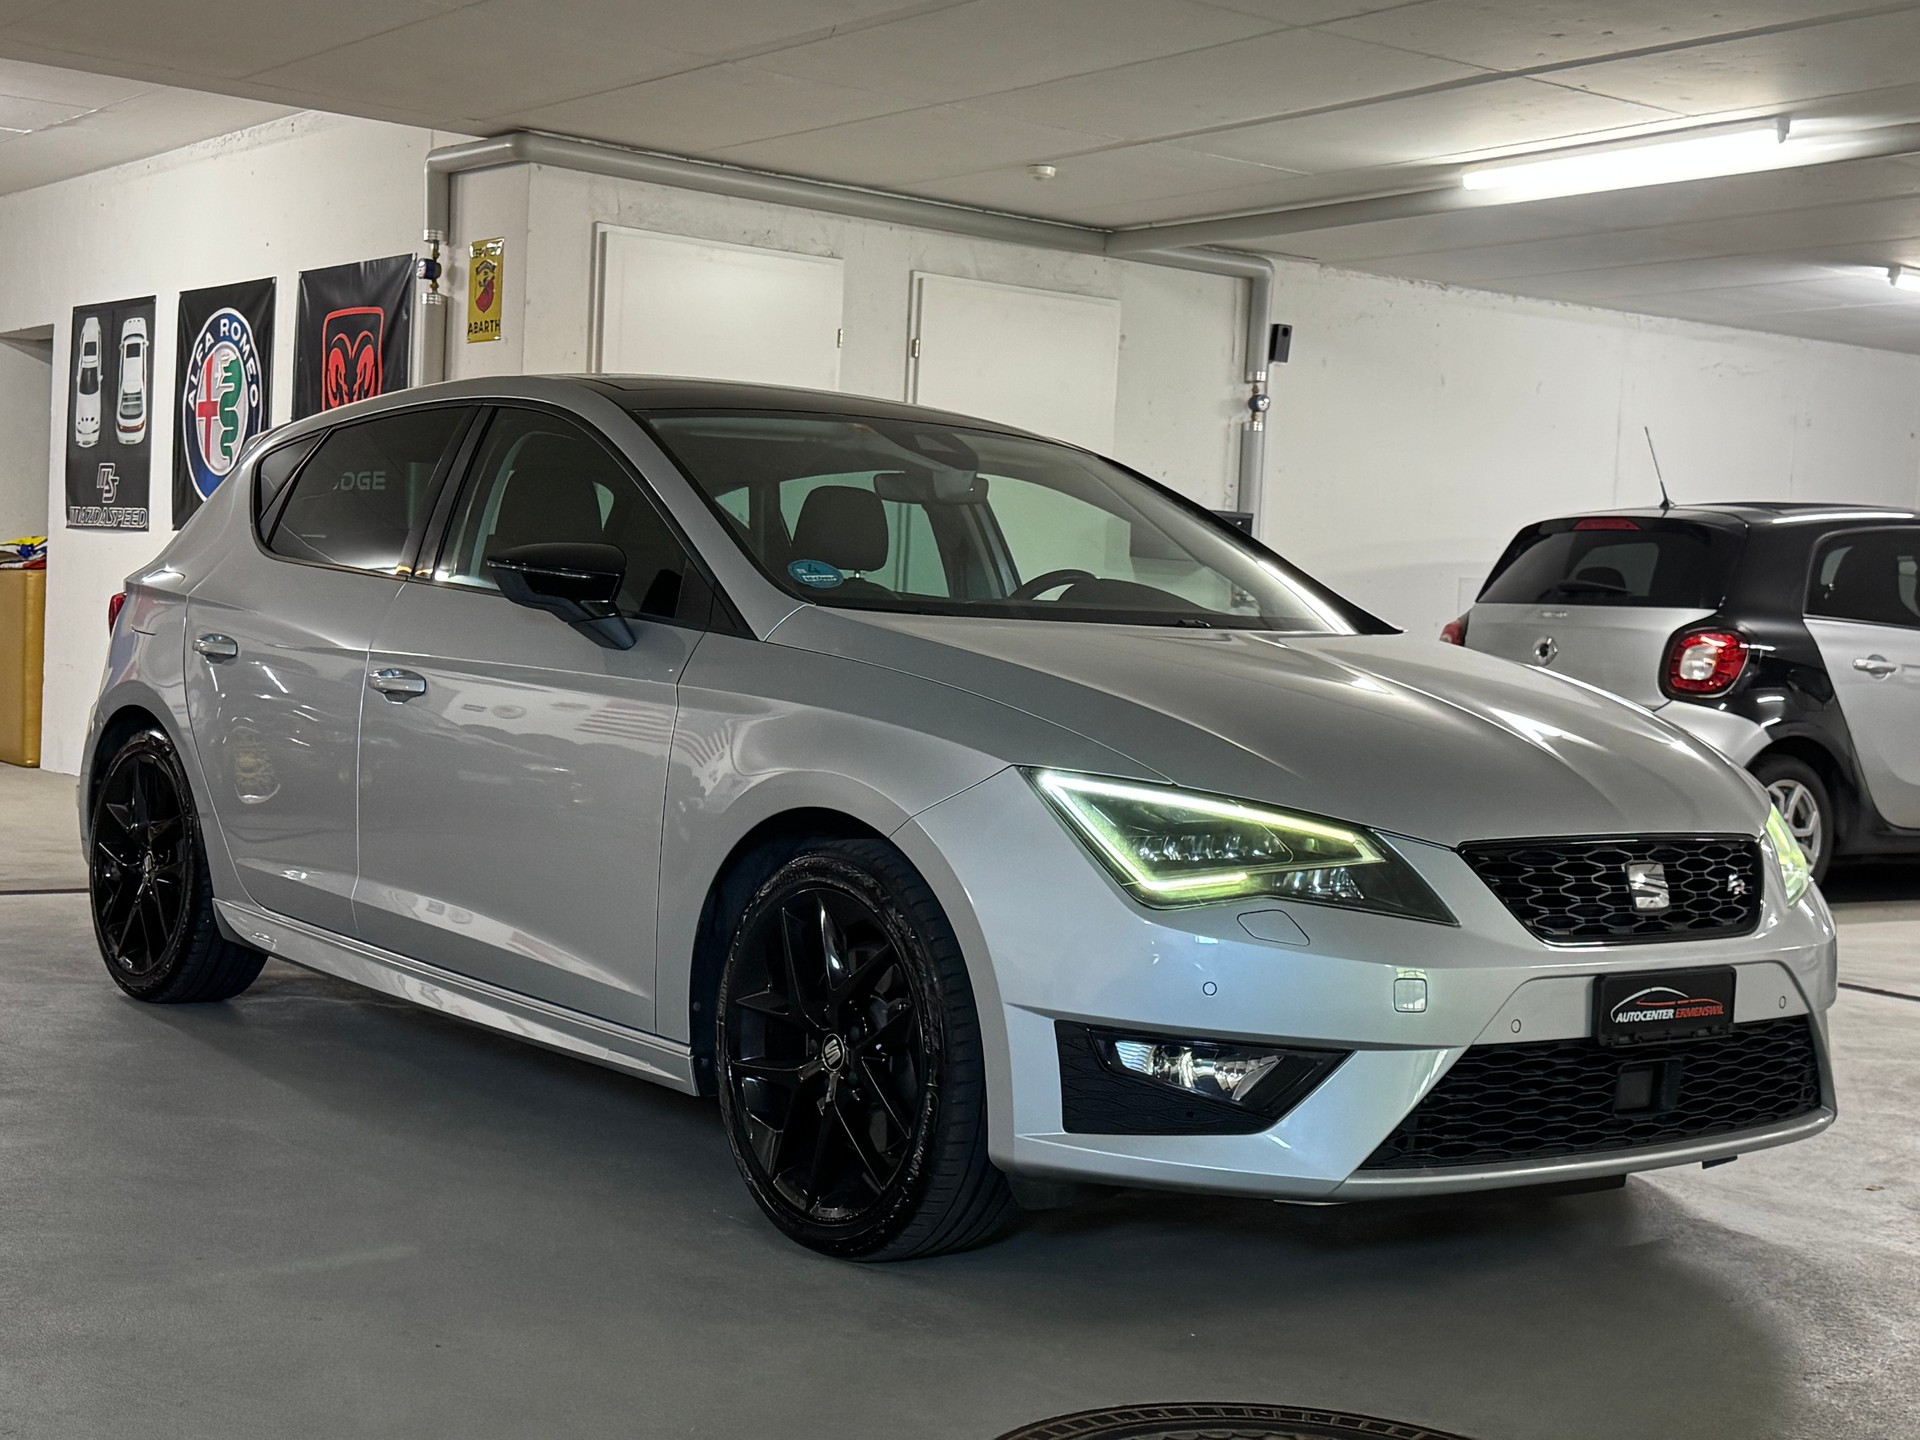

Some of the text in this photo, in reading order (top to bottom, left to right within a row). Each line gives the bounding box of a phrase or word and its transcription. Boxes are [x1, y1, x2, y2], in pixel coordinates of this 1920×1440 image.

[467, 319, 501, 335] ABARTH
[188, 318, 259, 411] ALFA ROMEO
[68, 505, 149, 529] MAZDASPEED
[1615, 1008, 1675, 1023] AUTOCENTER
